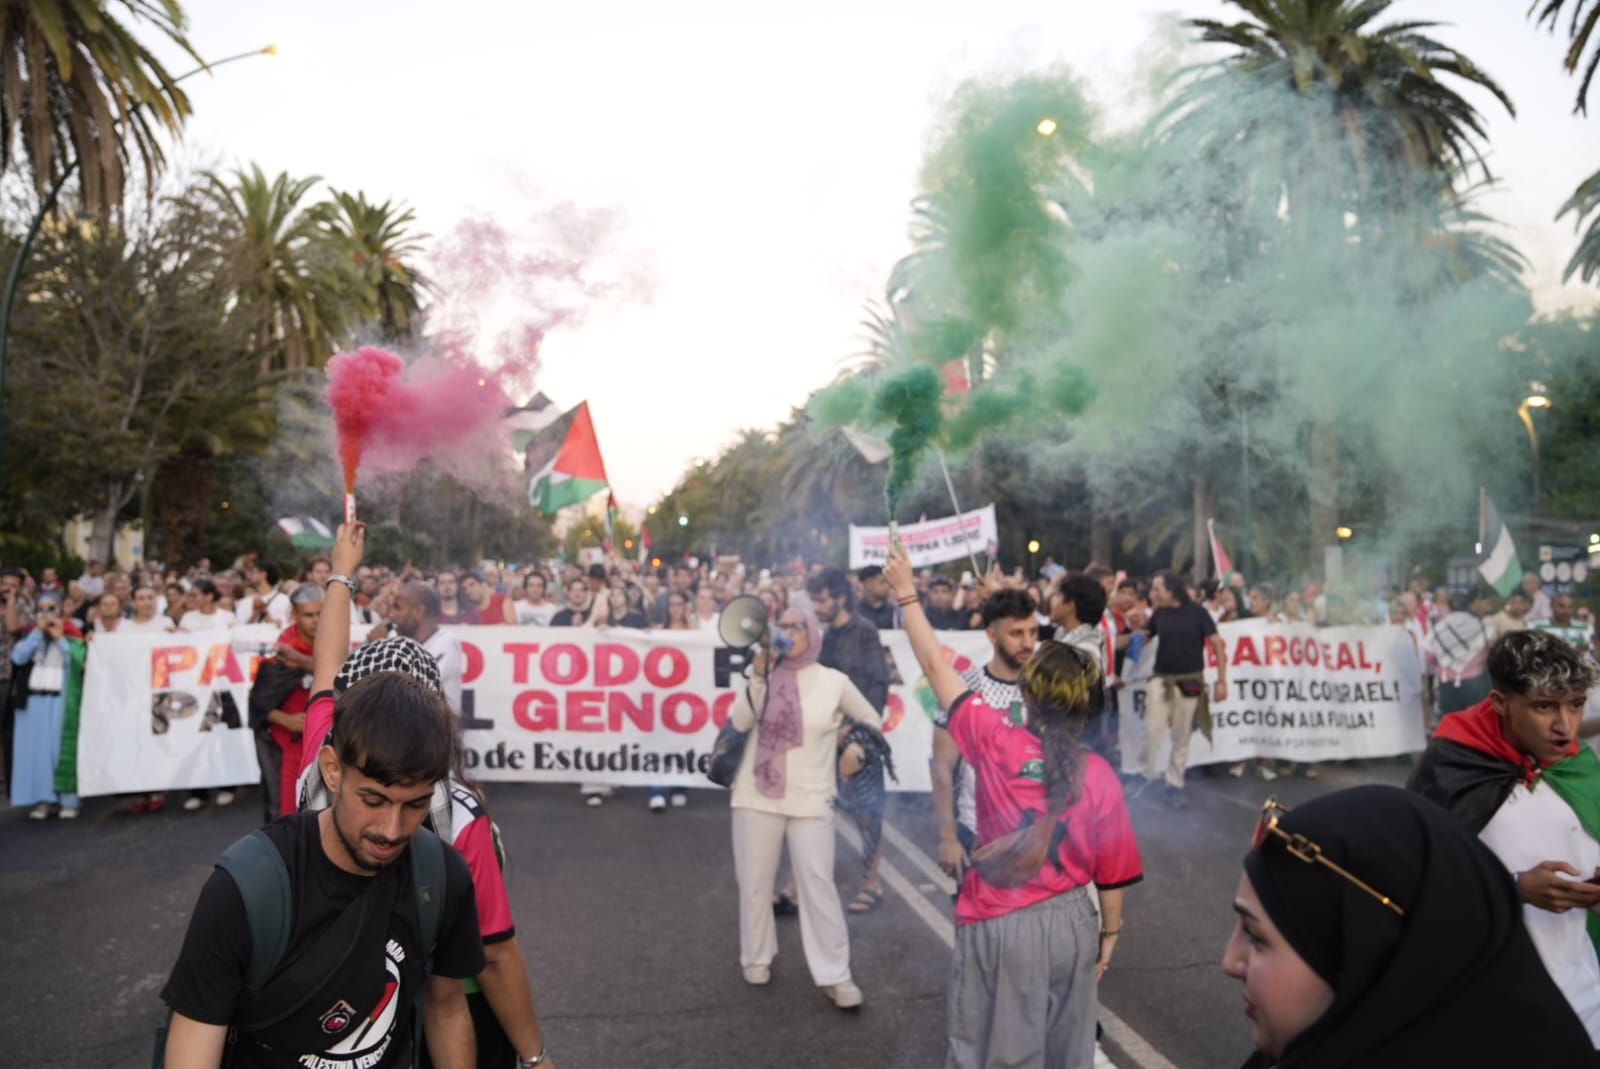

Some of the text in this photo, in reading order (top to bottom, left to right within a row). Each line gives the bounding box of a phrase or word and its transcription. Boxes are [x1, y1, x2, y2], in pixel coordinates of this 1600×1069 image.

[503, 643, 690, 688] TODO
[1234, 680, 1307, 702] TOTAL
[512, 690, 737, 734] GENOC
[484, 741, 525, 770] de
[533, 742, 712, 774] Estudiante
